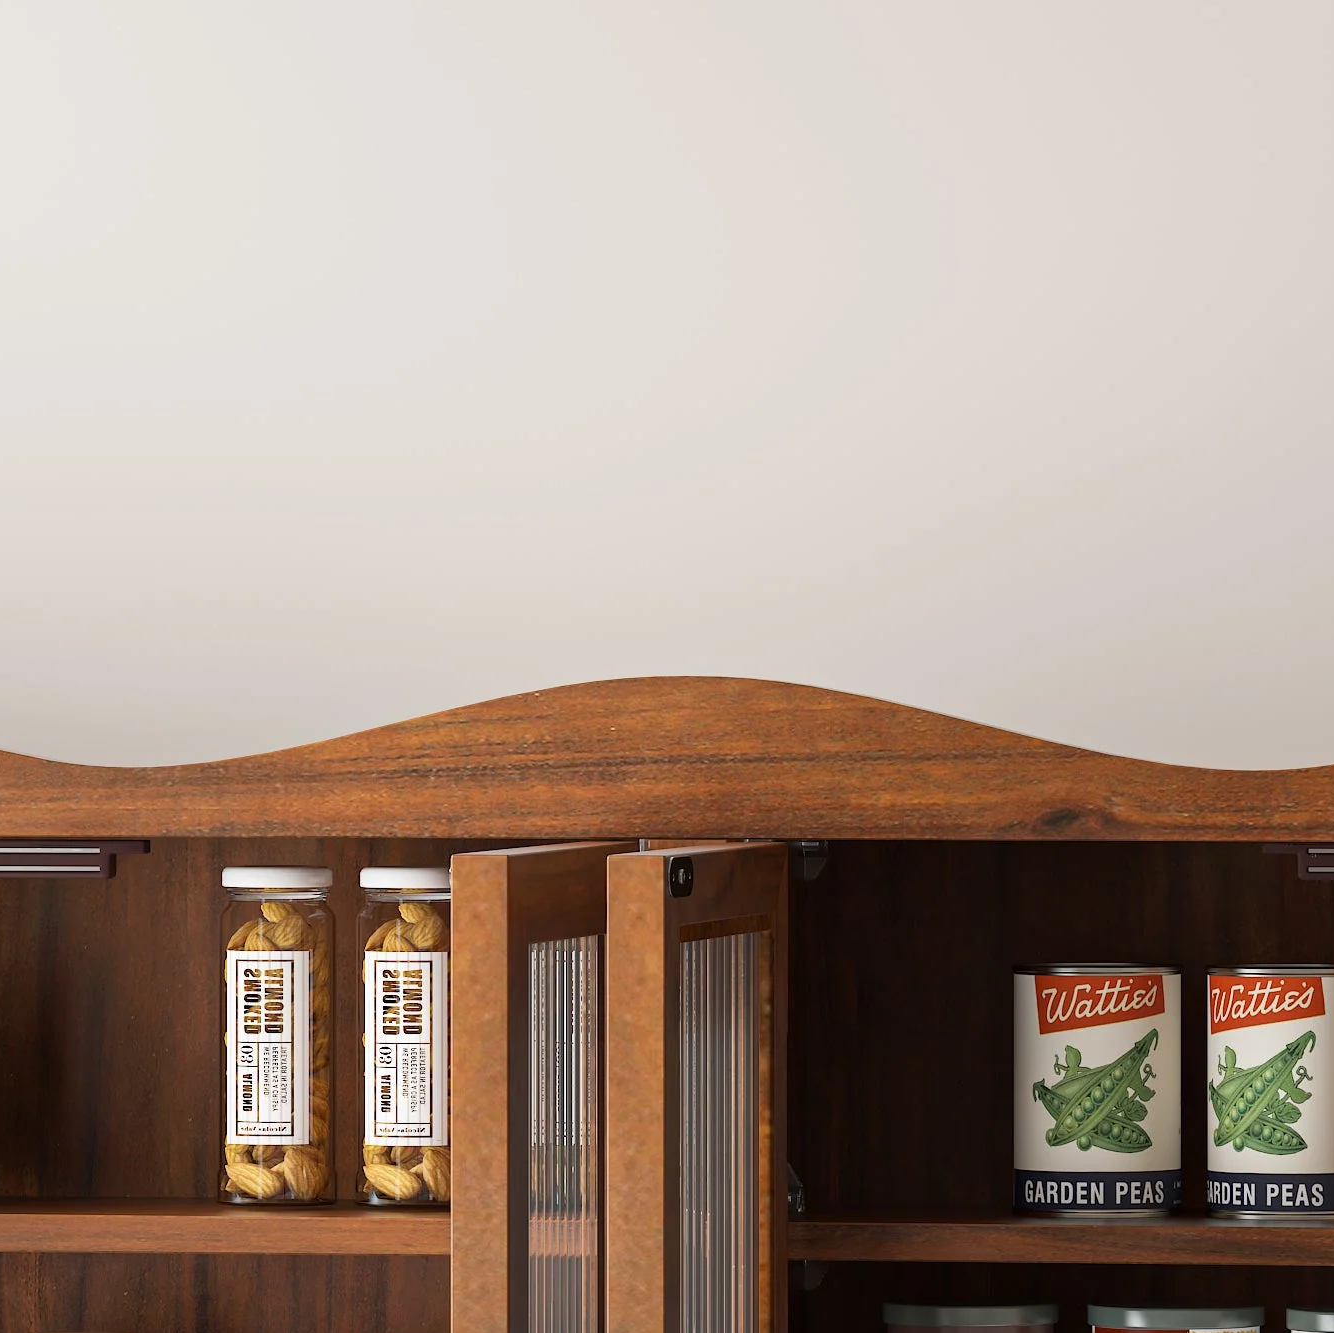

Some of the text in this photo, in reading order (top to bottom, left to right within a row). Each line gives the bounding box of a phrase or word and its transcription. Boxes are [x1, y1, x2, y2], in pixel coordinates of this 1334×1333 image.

[1042, 978, 1159, 1024] Wattie's
[1212, 979, 1315, 1024] Wattie's
[1024, 1179, 1165, 1205] GARDEN PEAS
[1266, 1183, 1324, 1207] PEAS
